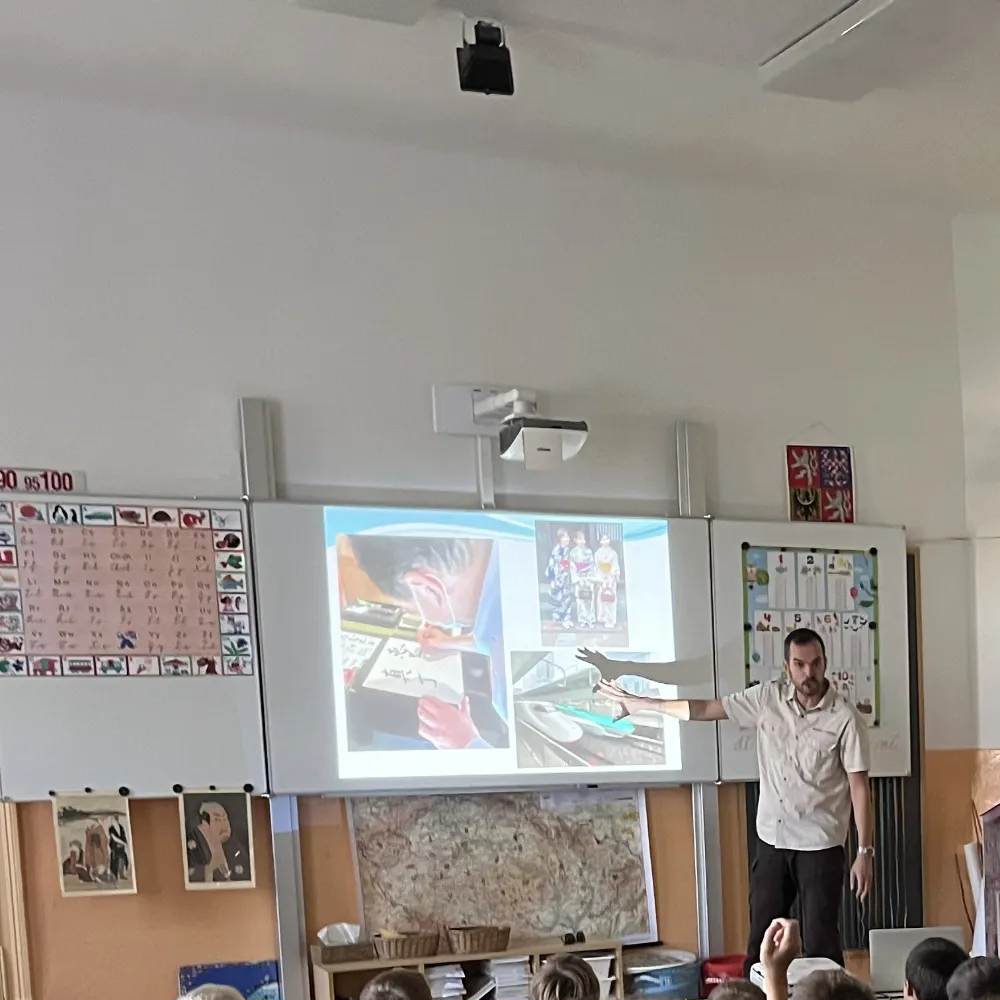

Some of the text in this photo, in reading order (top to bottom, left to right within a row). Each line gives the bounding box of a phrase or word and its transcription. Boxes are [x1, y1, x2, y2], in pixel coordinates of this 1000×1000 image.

[0, 469, 73, 491] 90 95 100
[778, 554, 783, 564] 1
[807, 555, 814, 564] 2
[764, 613, 771, 622] 4
[838, 672, 848, 680] 10
